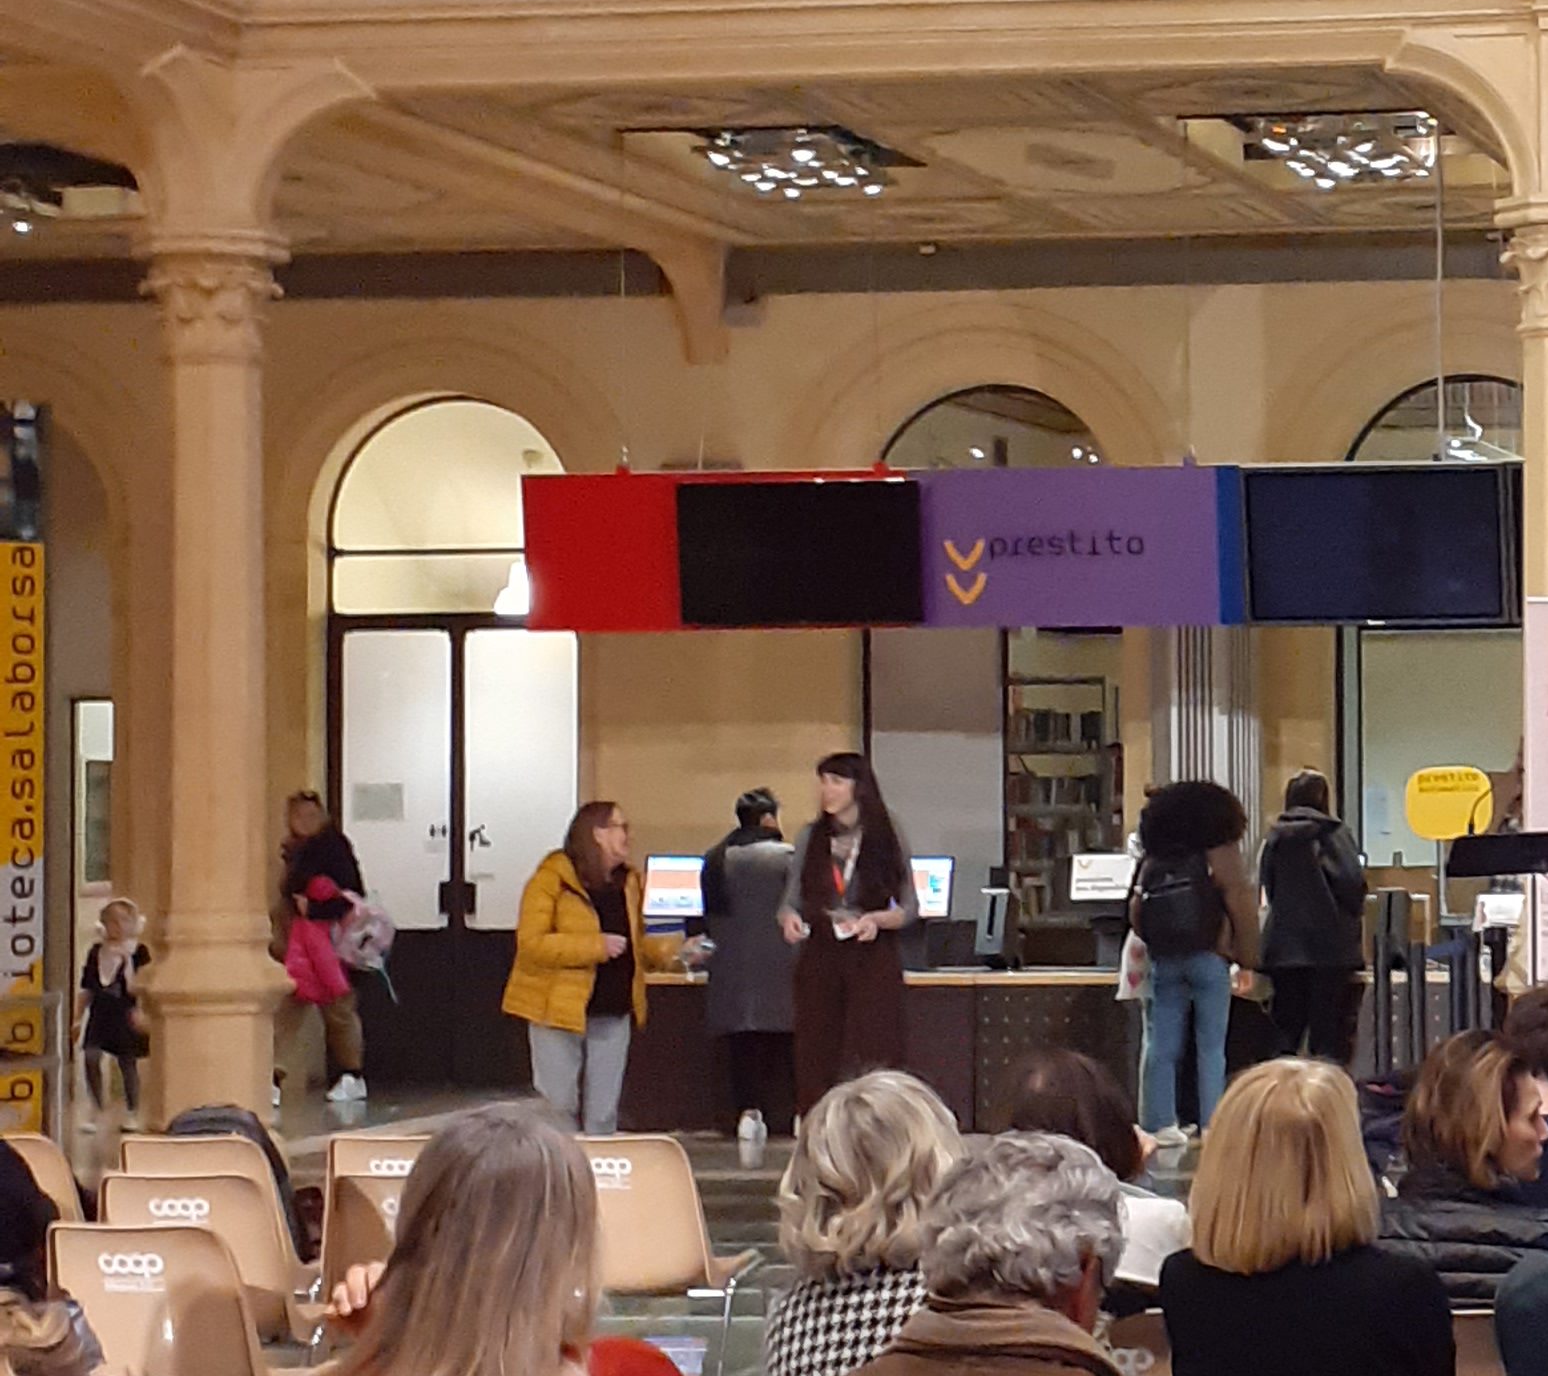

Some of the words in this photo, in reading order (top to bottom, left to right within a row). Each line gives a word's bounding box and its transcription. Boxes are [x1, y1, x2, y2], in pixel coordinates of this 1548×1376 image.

[989, 530, 1145, 560] prestito
[0, 546, 35, 1102] bbioteca.salaborsa
[370, 1159, 414, 1176] coo
[590, 1157, 632, 1180] oop
[148, 1197, 210, 1221] coop
[98, 1251, 165, 1279] coop
